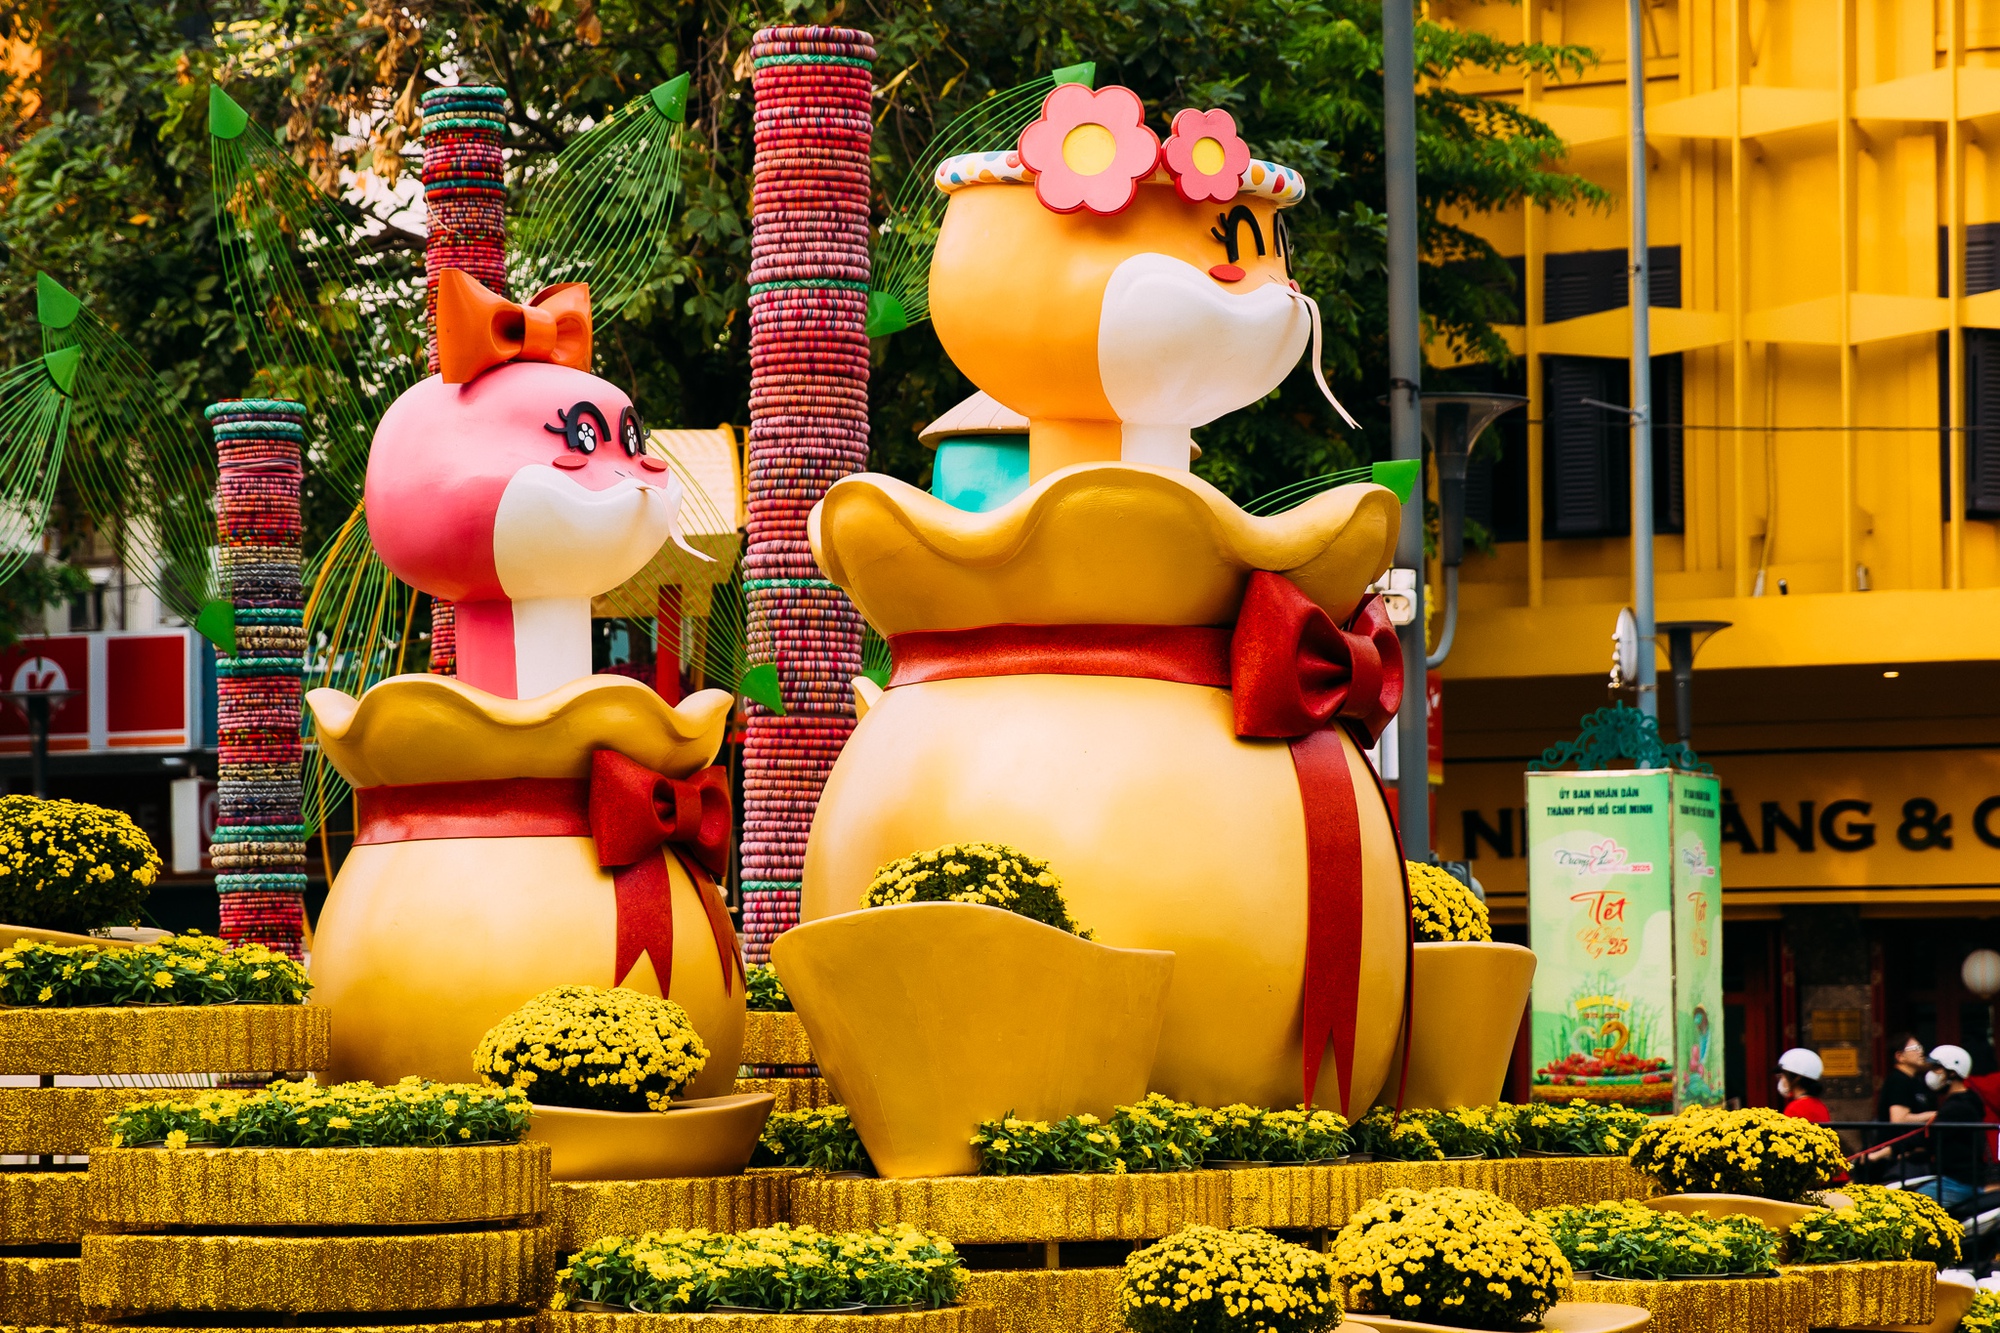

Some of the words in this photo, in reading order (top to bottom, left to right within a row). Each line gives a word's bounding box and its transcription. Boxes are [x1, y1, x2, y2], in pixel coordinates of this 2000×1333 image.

[1573, 789, 1591, 799] BAN
[1629, 804, 1653, 814] MINH
[1897, 797, 1953, 852] &
